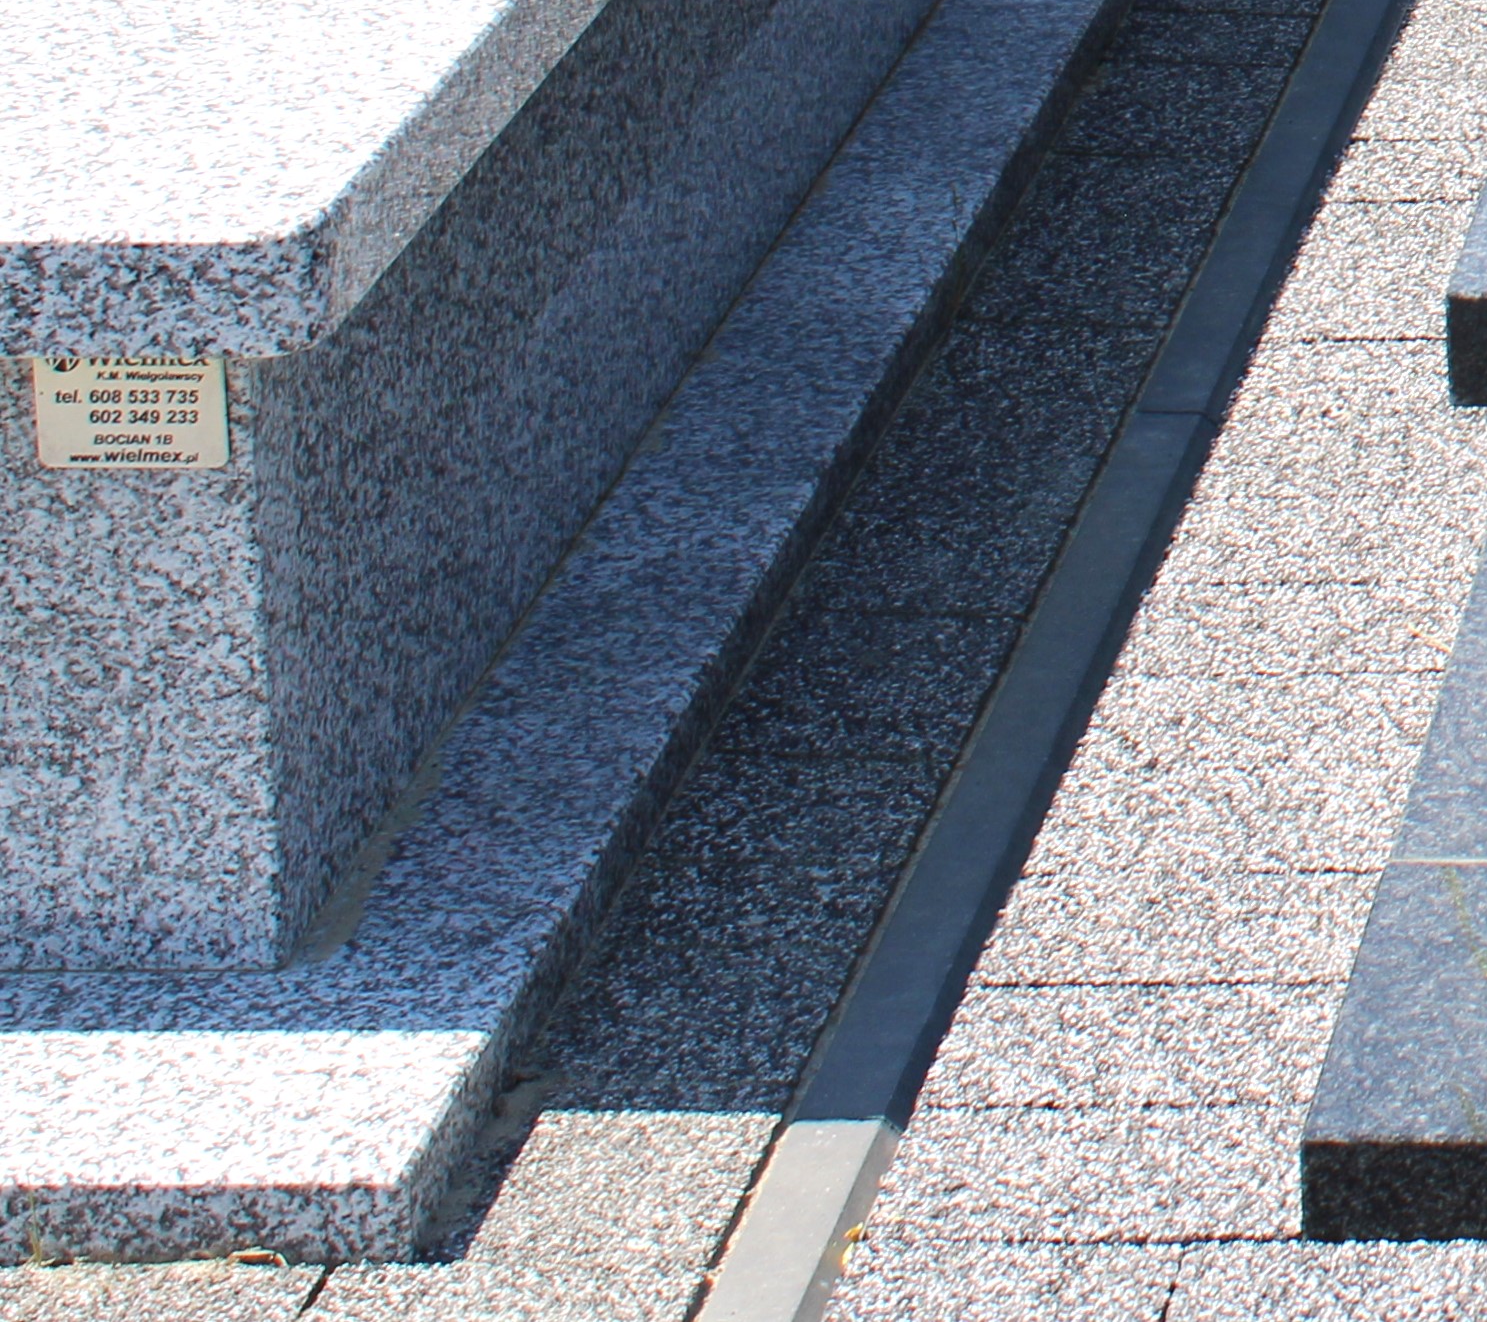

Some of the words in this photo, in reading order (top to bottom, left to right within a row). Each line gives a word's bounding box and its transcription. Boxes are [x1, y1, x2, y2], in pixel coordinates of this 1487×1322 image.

[55, 389, 83, 404] tel.
[89, 389, 122, 404] 608
[128, 389, 161, 404] 533
[166, 389, 199, 404] 735
[89, 409, 122, 424] 602
[128, 409, 161, 424] 349
[166, 409, 199, 424] 233
[94, 434, 151, 445] BOCIAN
[155, 434, 174, 445] 1B
[69, 447, 200, 464] www.wielmex.pl
